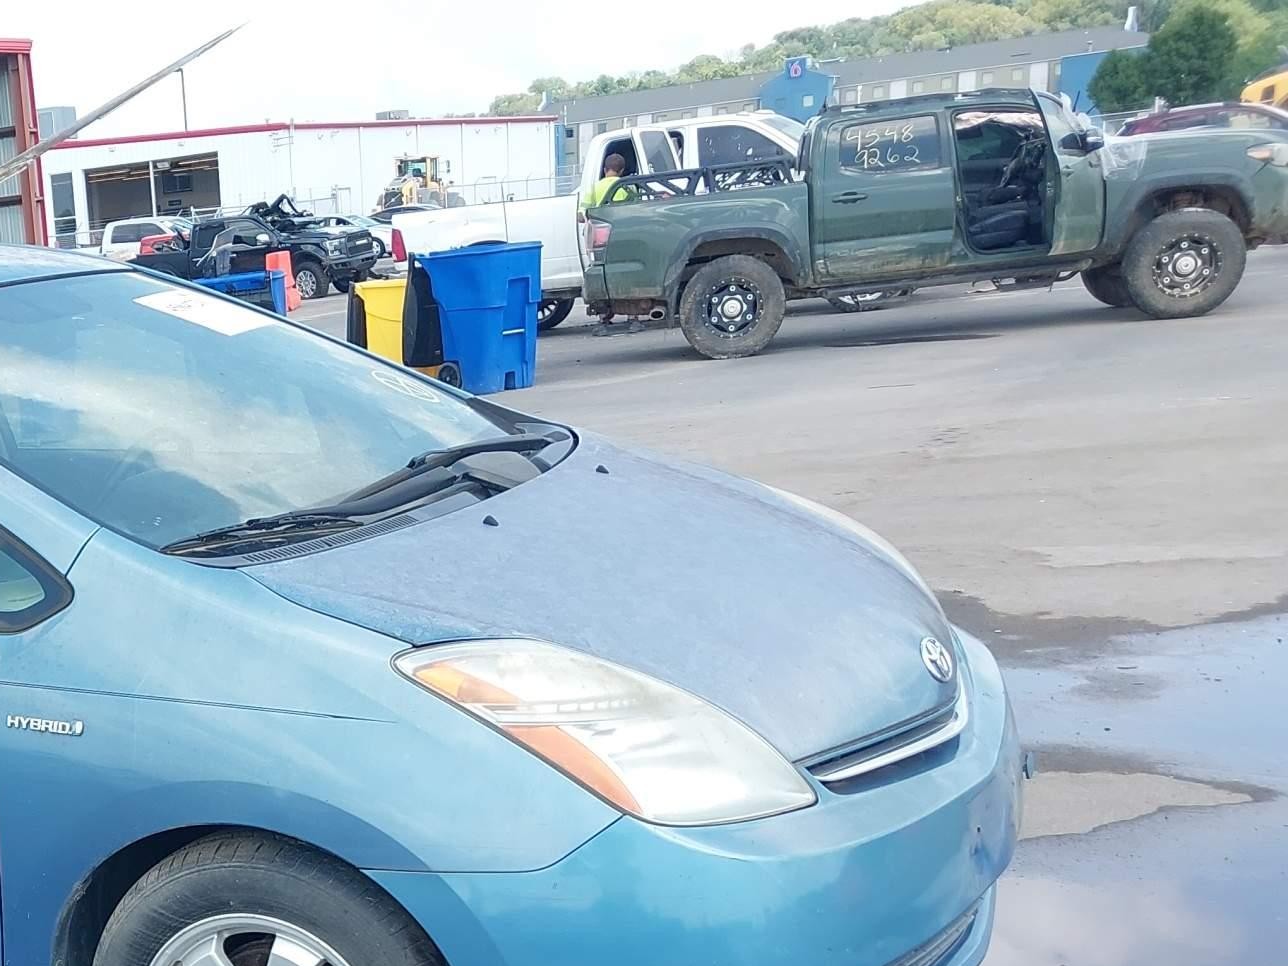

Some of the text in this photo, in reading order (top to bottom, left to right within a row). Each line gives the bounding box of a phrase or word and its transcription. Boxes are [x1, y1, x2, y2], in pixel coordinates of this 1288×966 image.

[845, 124, 914, 151] 4548
[854, 145, 921, 168] 9262
[6, 714, 71, 735] HYBRID
